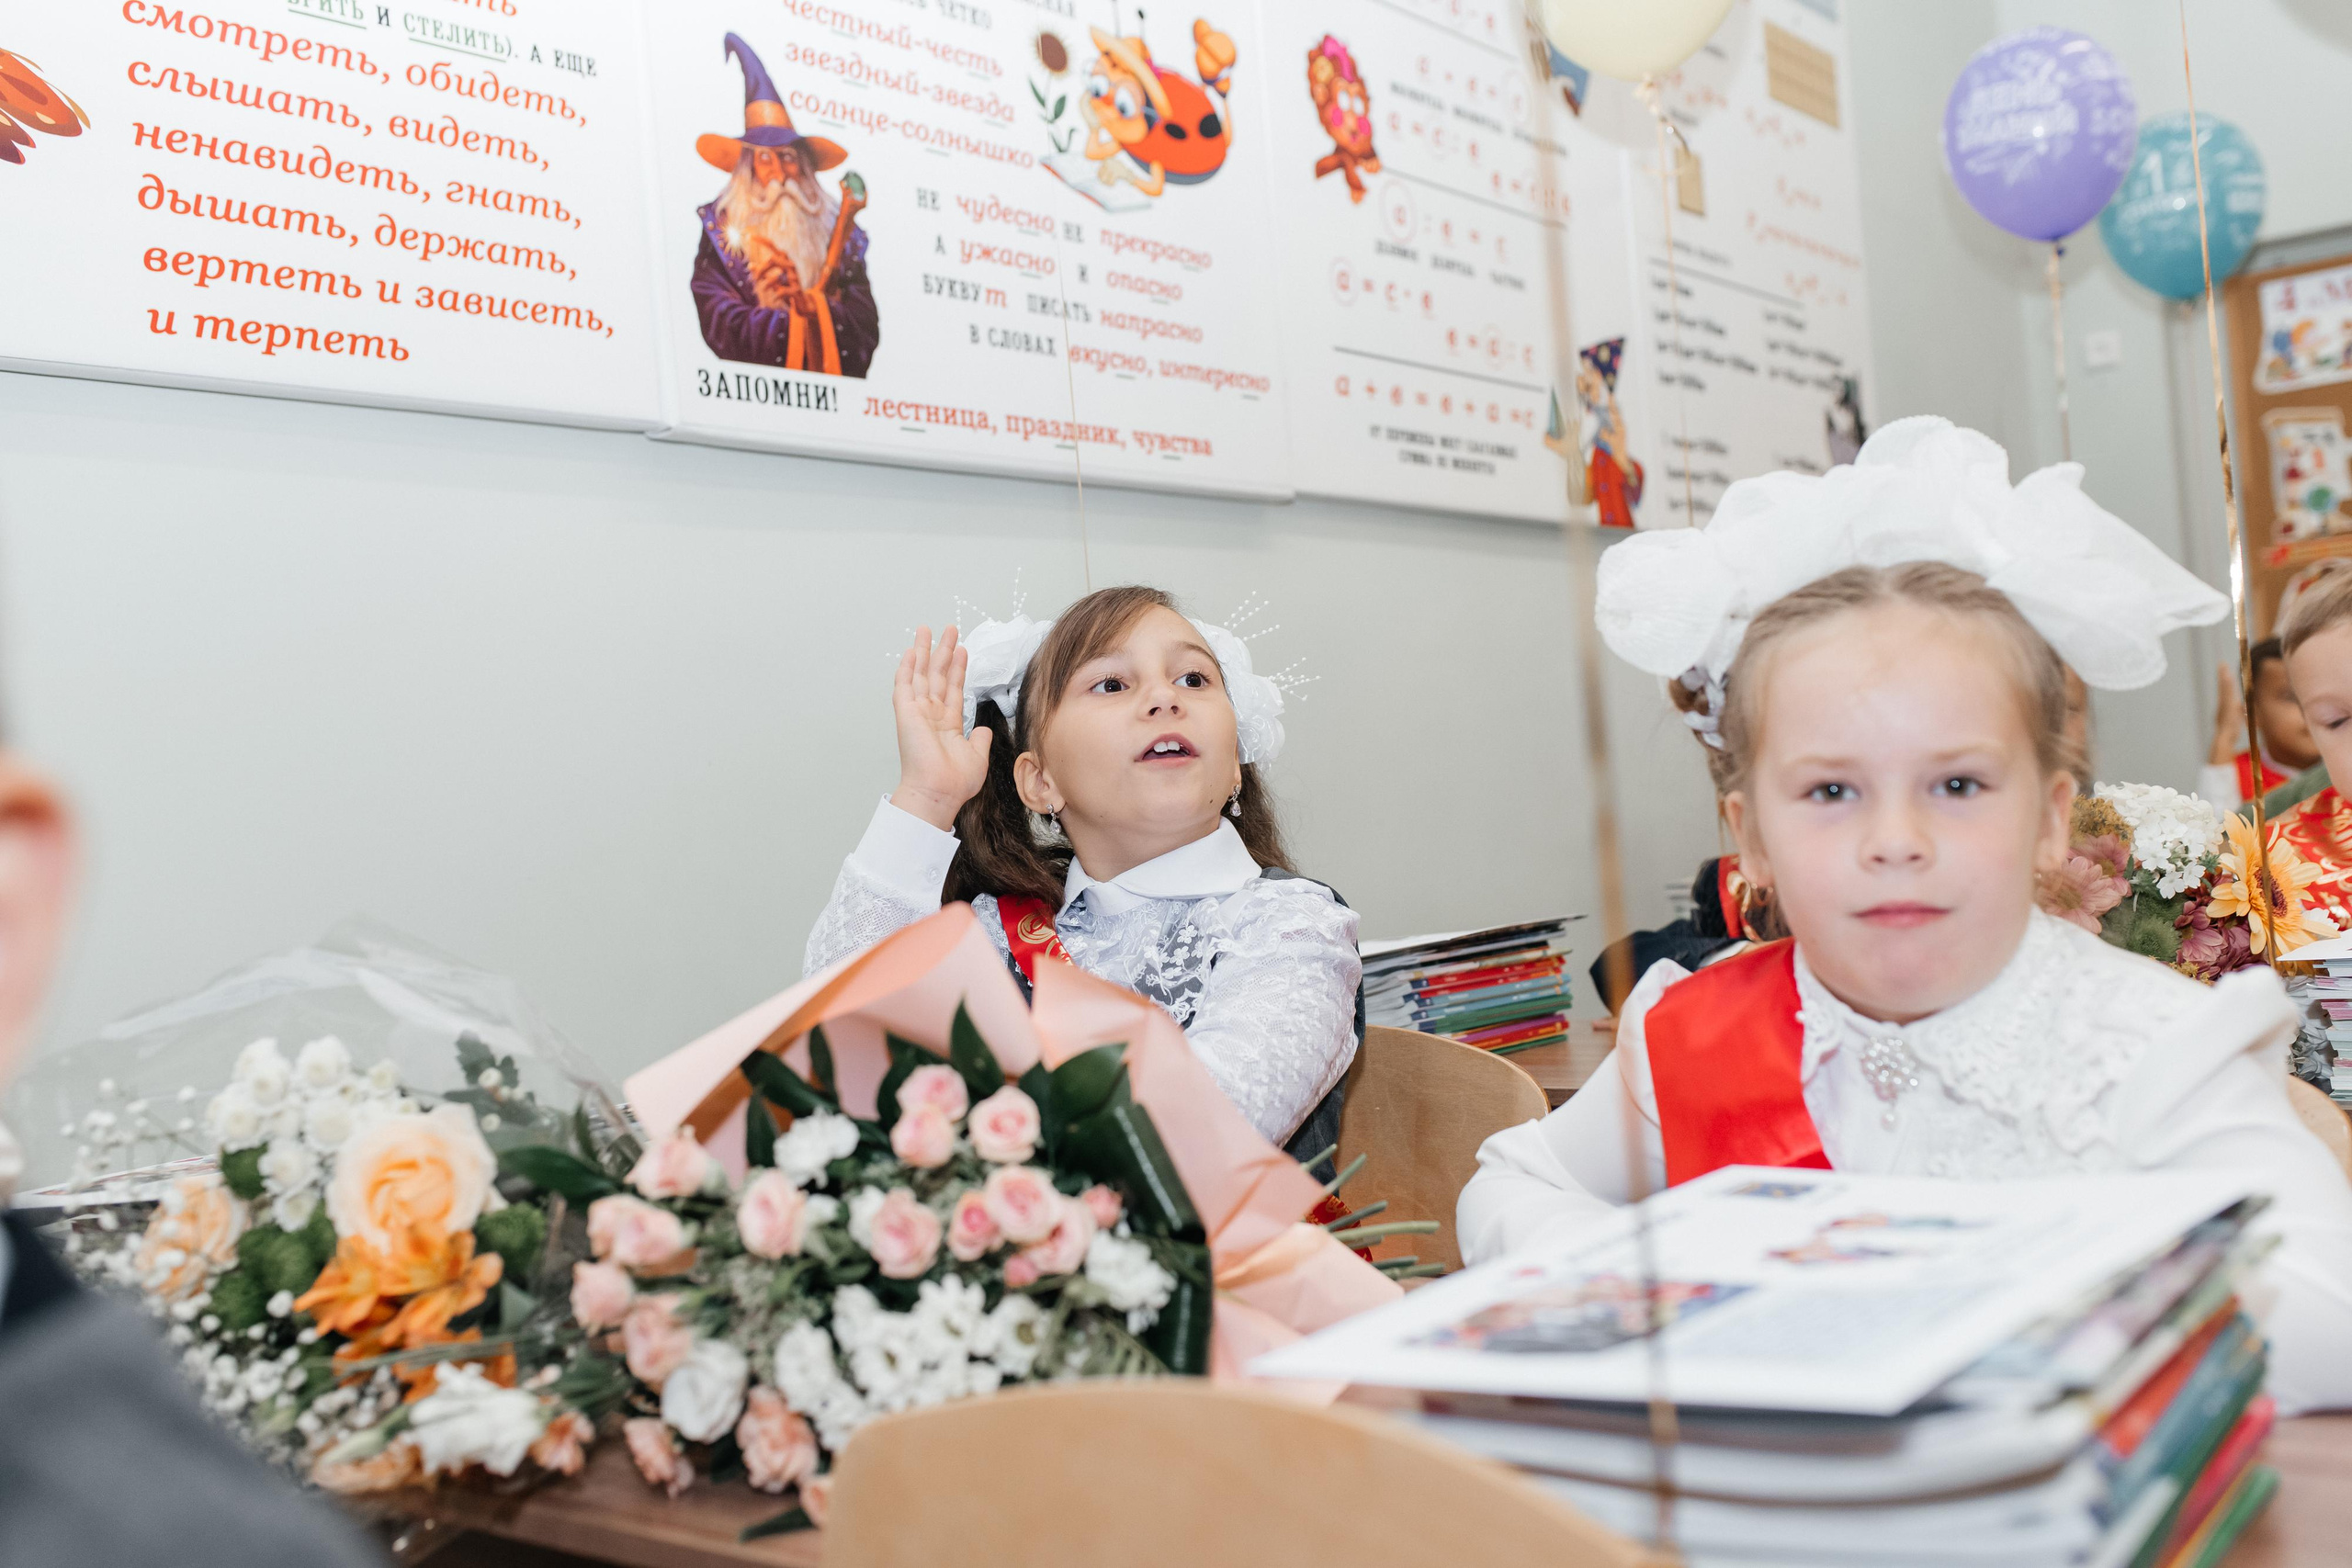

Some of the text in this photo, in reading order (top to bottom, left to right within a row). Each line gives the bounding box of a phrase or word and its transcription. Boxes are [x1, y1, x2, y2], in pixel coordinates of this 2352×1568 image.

[121, 0, 588, 127] смотреть, обидеть,
[288, 0, 364, 20] ИТЬ
[377, 6, 390, 27] И
[530, 44, 543, 63] А
[127, 61, 551, 171] слышать, видеть,
[786, 42, 1015, 123] звездный-звезда
[789, 89, 1035, 168] солнце-солнышко
[133, 121, 583, 231] ненавидеть, гнать,
[137, 174, 578, 282] дышать, держать,
[142, 246, 616, 339] вертеть и зависеть,
[960, 239, 1056, 275] ужасно
[1106, 271, 1182, 300] опасно
[147, 309, 411, 363] и терпеть
[969, 323, 980, 344] В
[1100, 310, 1204, 344] напрасно
[697, 369, 838, 412] ЗАПОМНИ!
[864, 396, 998, 434] лестница,
[1006, 412, 1126, 450] праздник,
